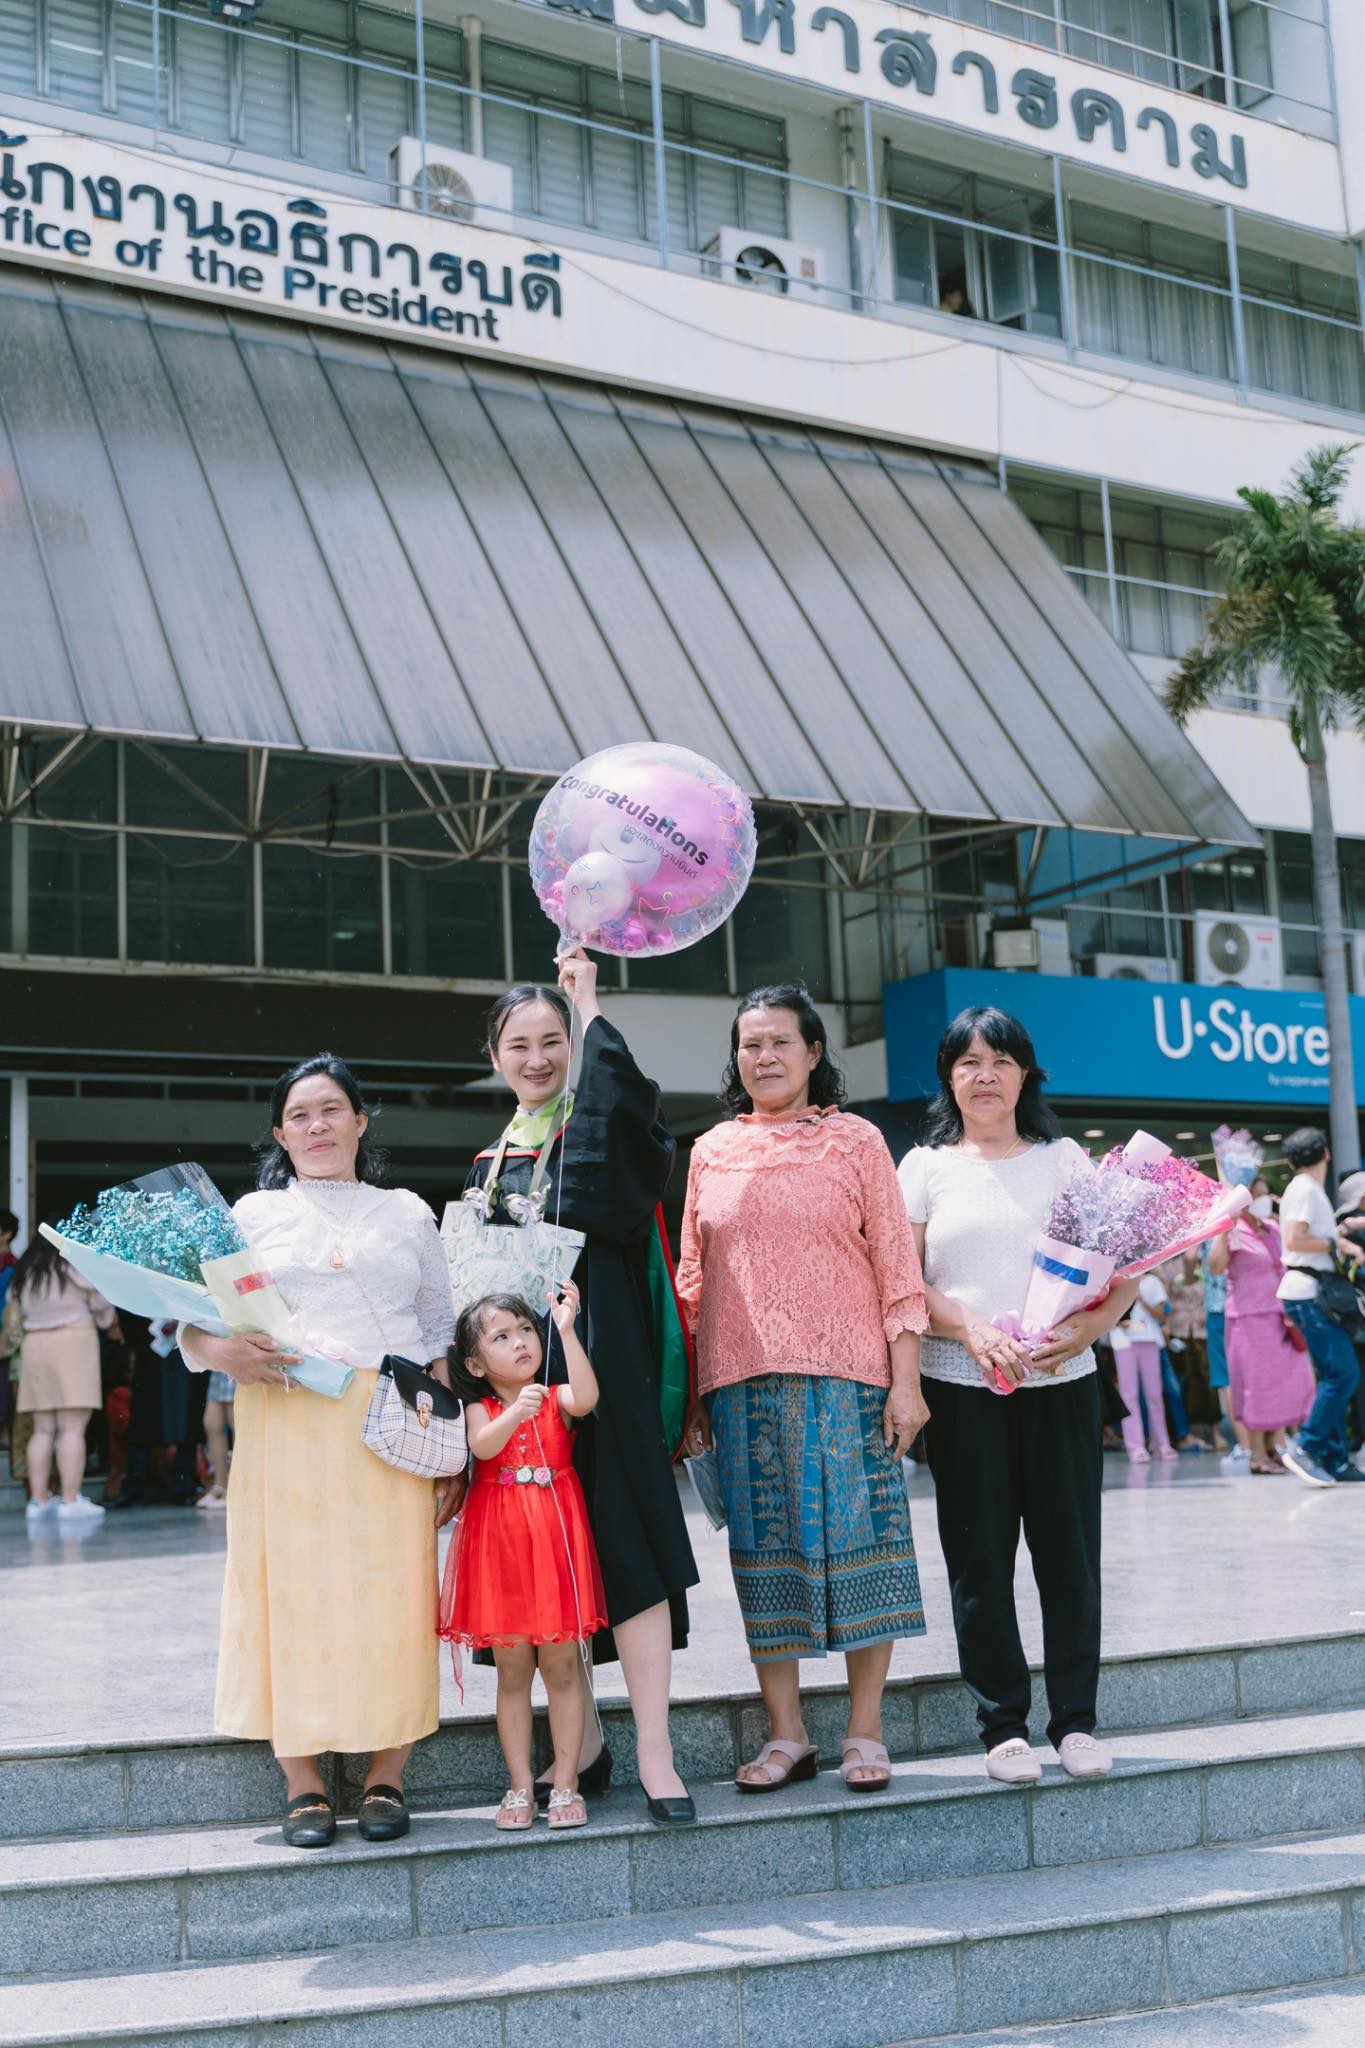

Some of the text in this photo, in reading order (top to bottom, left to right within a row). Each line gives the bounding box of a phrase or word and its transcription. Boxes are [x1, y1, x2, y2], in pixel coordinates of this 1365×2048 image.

[115, 238, 163, 272] of
[186, 246, 265, 292] the
[283, 265, 500, 341] President
